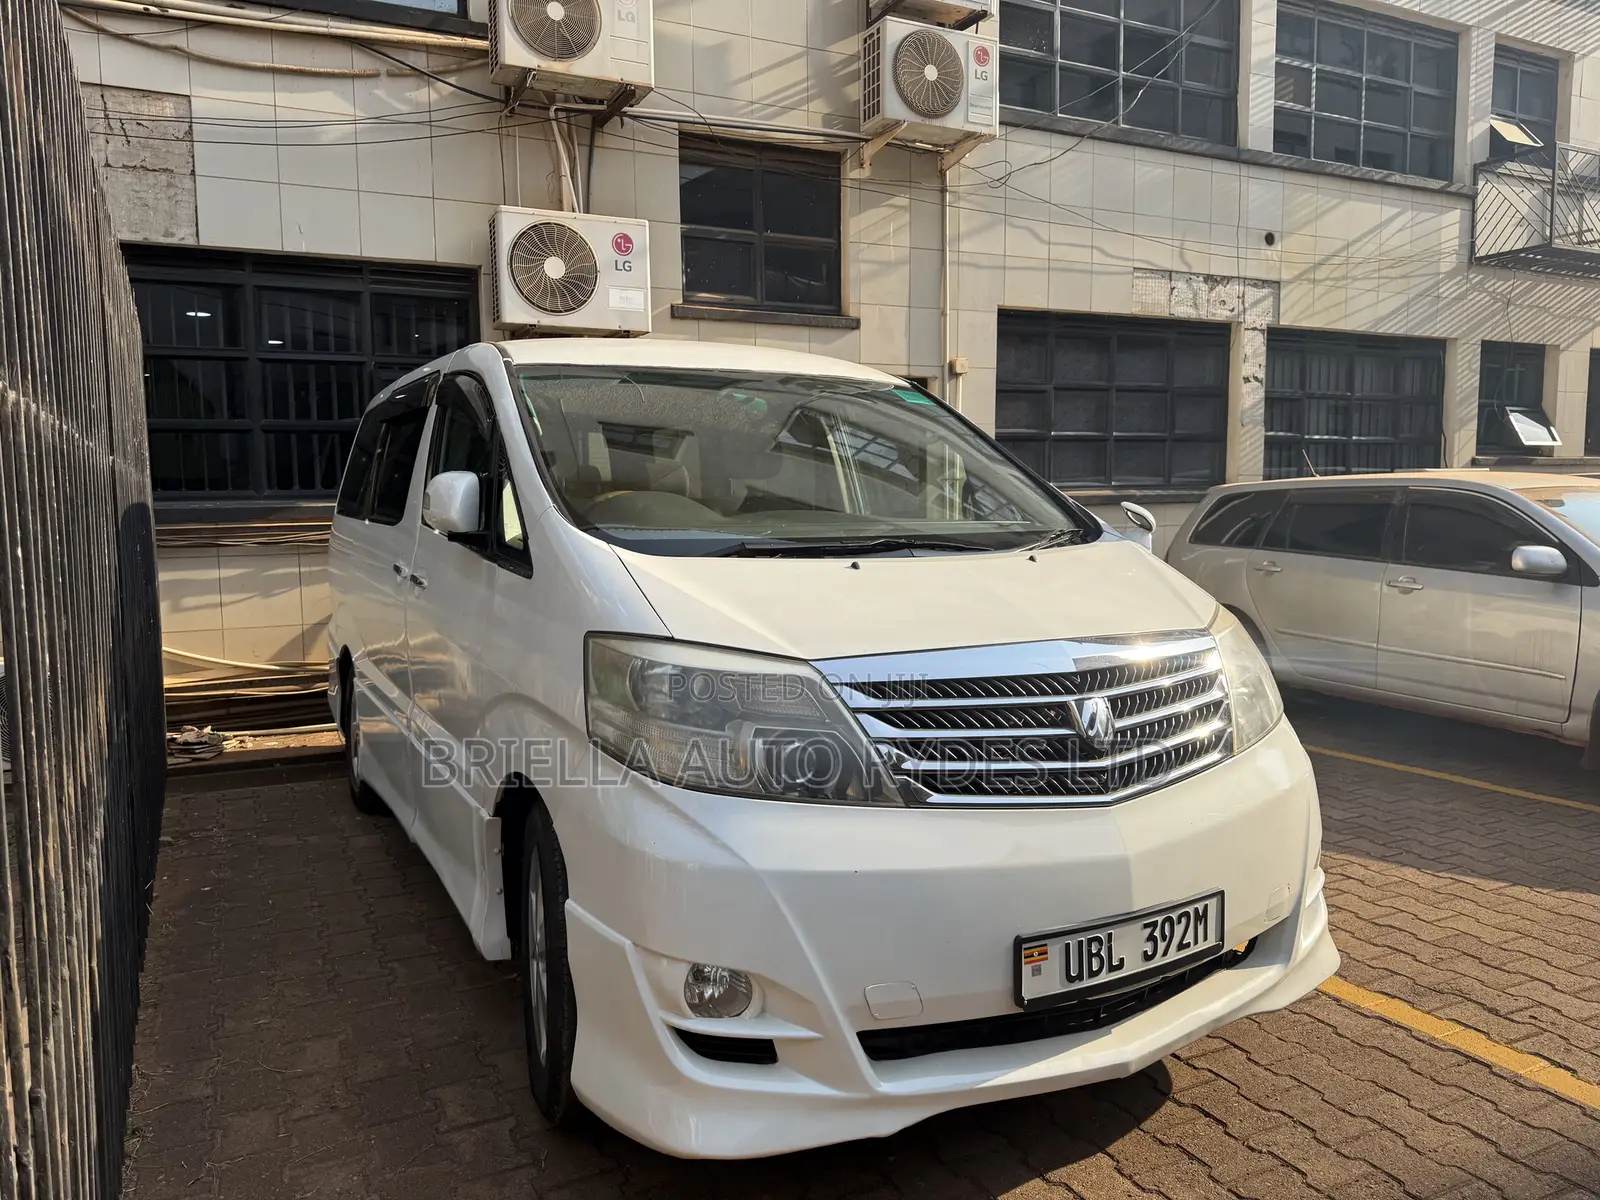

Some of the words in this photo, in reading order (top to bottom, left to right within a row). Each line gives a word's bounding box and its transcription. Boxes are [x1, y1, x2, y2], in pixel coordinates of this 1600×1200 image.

[617, 9, 636, 24] LG
[974, 69, 988, 81] LG
[614, 259, 633, 272] LG
[1064, 930, 1125, 984] UBL
[1142, 903, 1209, 962] 392M
